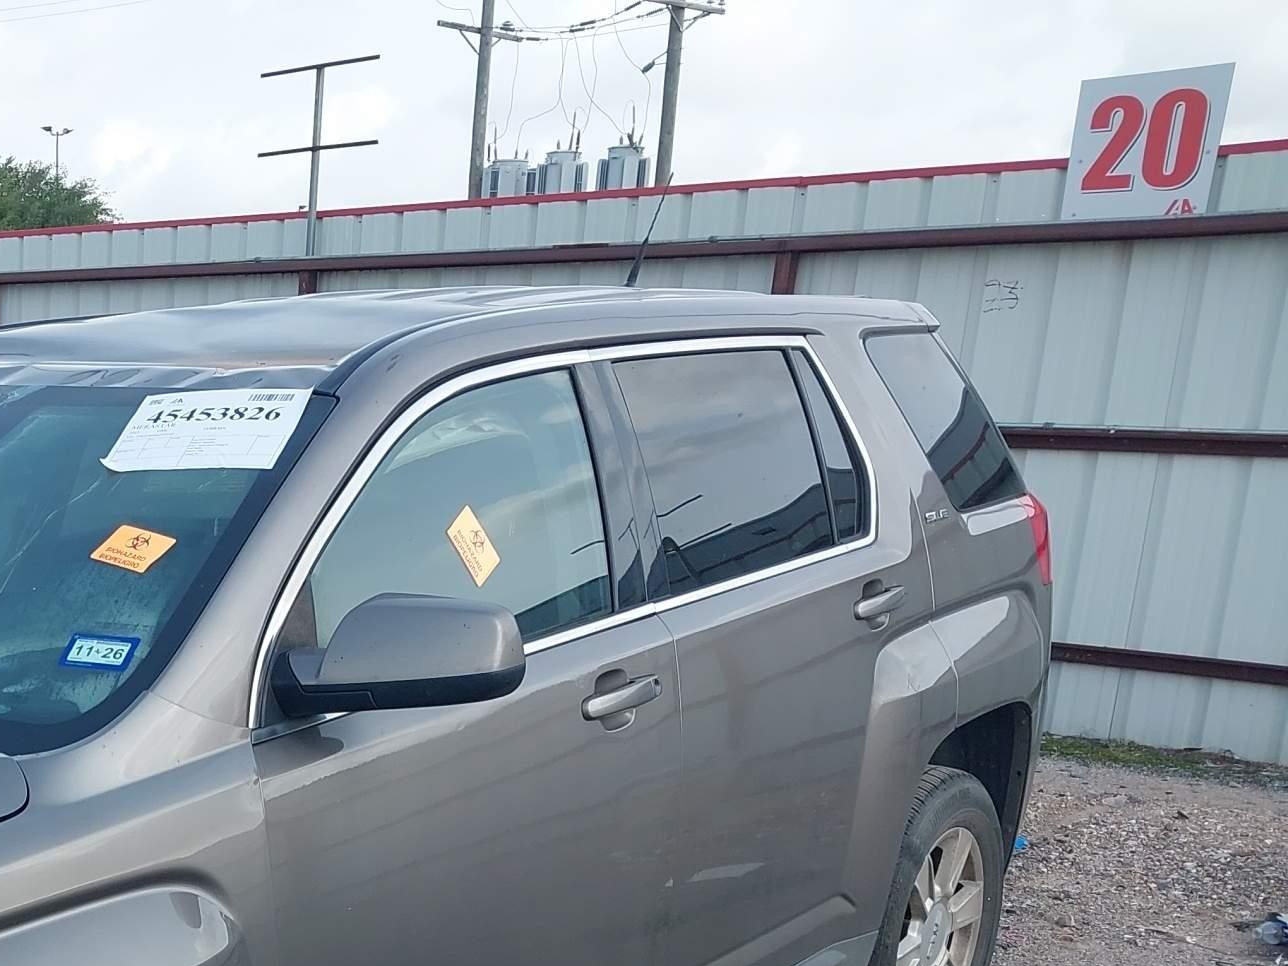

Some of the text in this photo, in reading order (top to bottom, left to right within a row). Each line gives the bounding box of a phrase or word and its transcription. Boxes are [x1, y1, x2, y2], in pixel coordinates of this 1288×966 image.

[1080, 87, 1211, 193] 20
[146, 406, 285, 424] 45453826
[105, 546, 147, 562] BIOHAZARD
